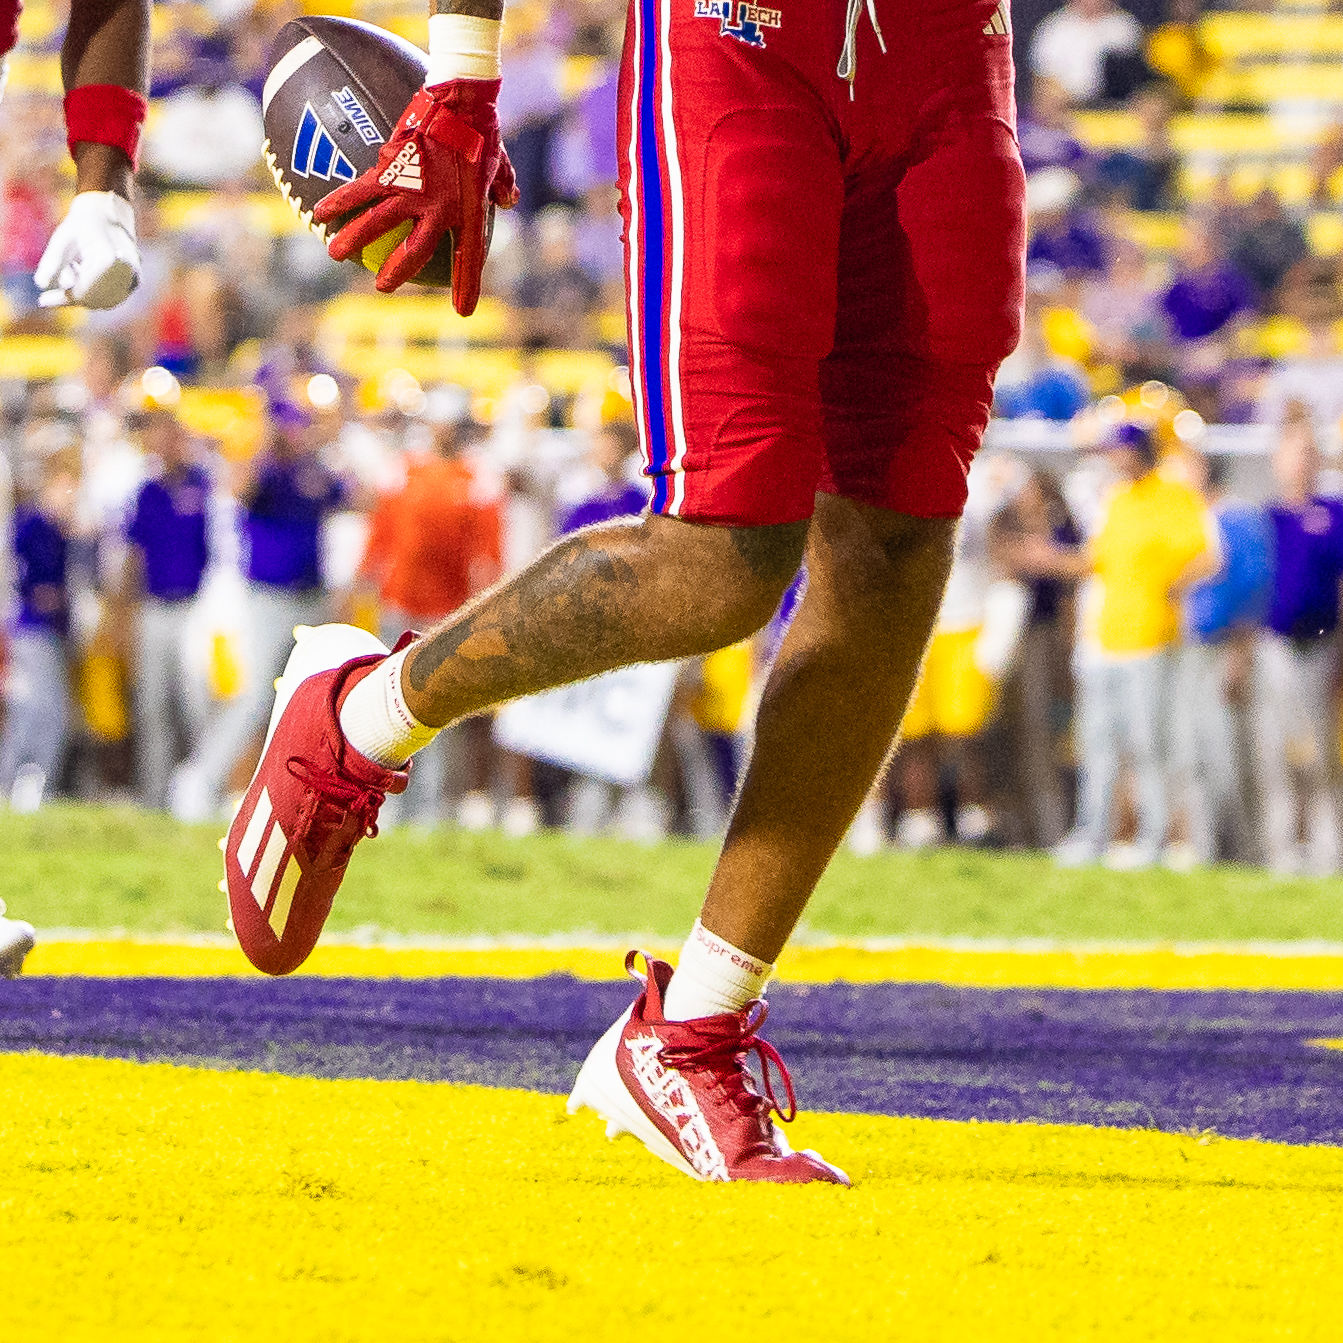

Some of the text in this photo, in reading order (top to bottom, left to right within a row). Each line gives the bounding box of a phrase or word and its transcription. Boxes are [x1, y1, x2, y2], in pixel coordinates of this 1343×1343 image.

[332, 86, 385, 146] DIME
[377, 140, 417, 186] adidas
[696, 926, 763, 977] Supreme
